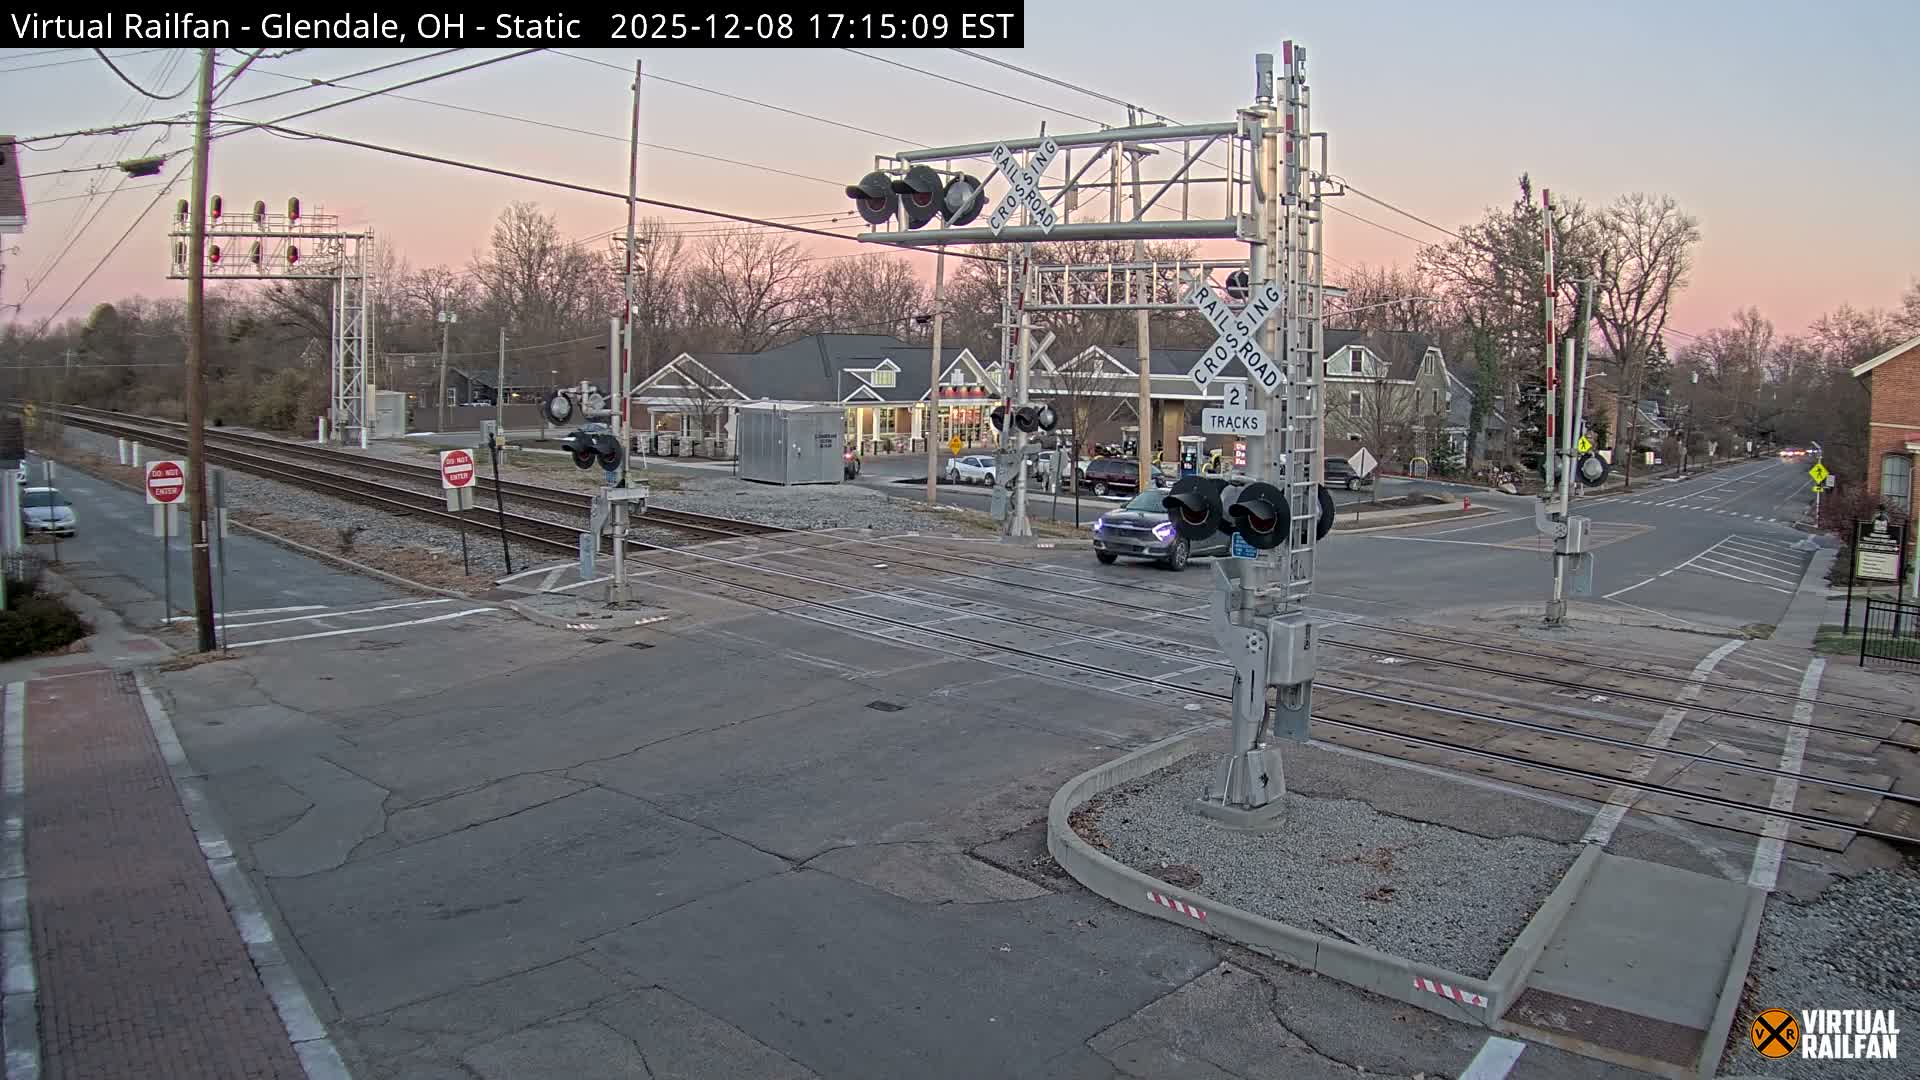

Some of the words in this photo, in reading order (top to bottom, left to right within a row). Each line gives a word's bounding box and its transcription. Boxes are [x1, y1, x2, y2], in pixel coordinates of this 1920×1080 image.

[1194, 287, 1279, 384] CROSSING
[1230, 387, 1240, 406] 2
[1211, 416, 1258, 430] TRACKS
[164, 468, 178, 476] NOT
[155, 487, 177, 496] ENTER
